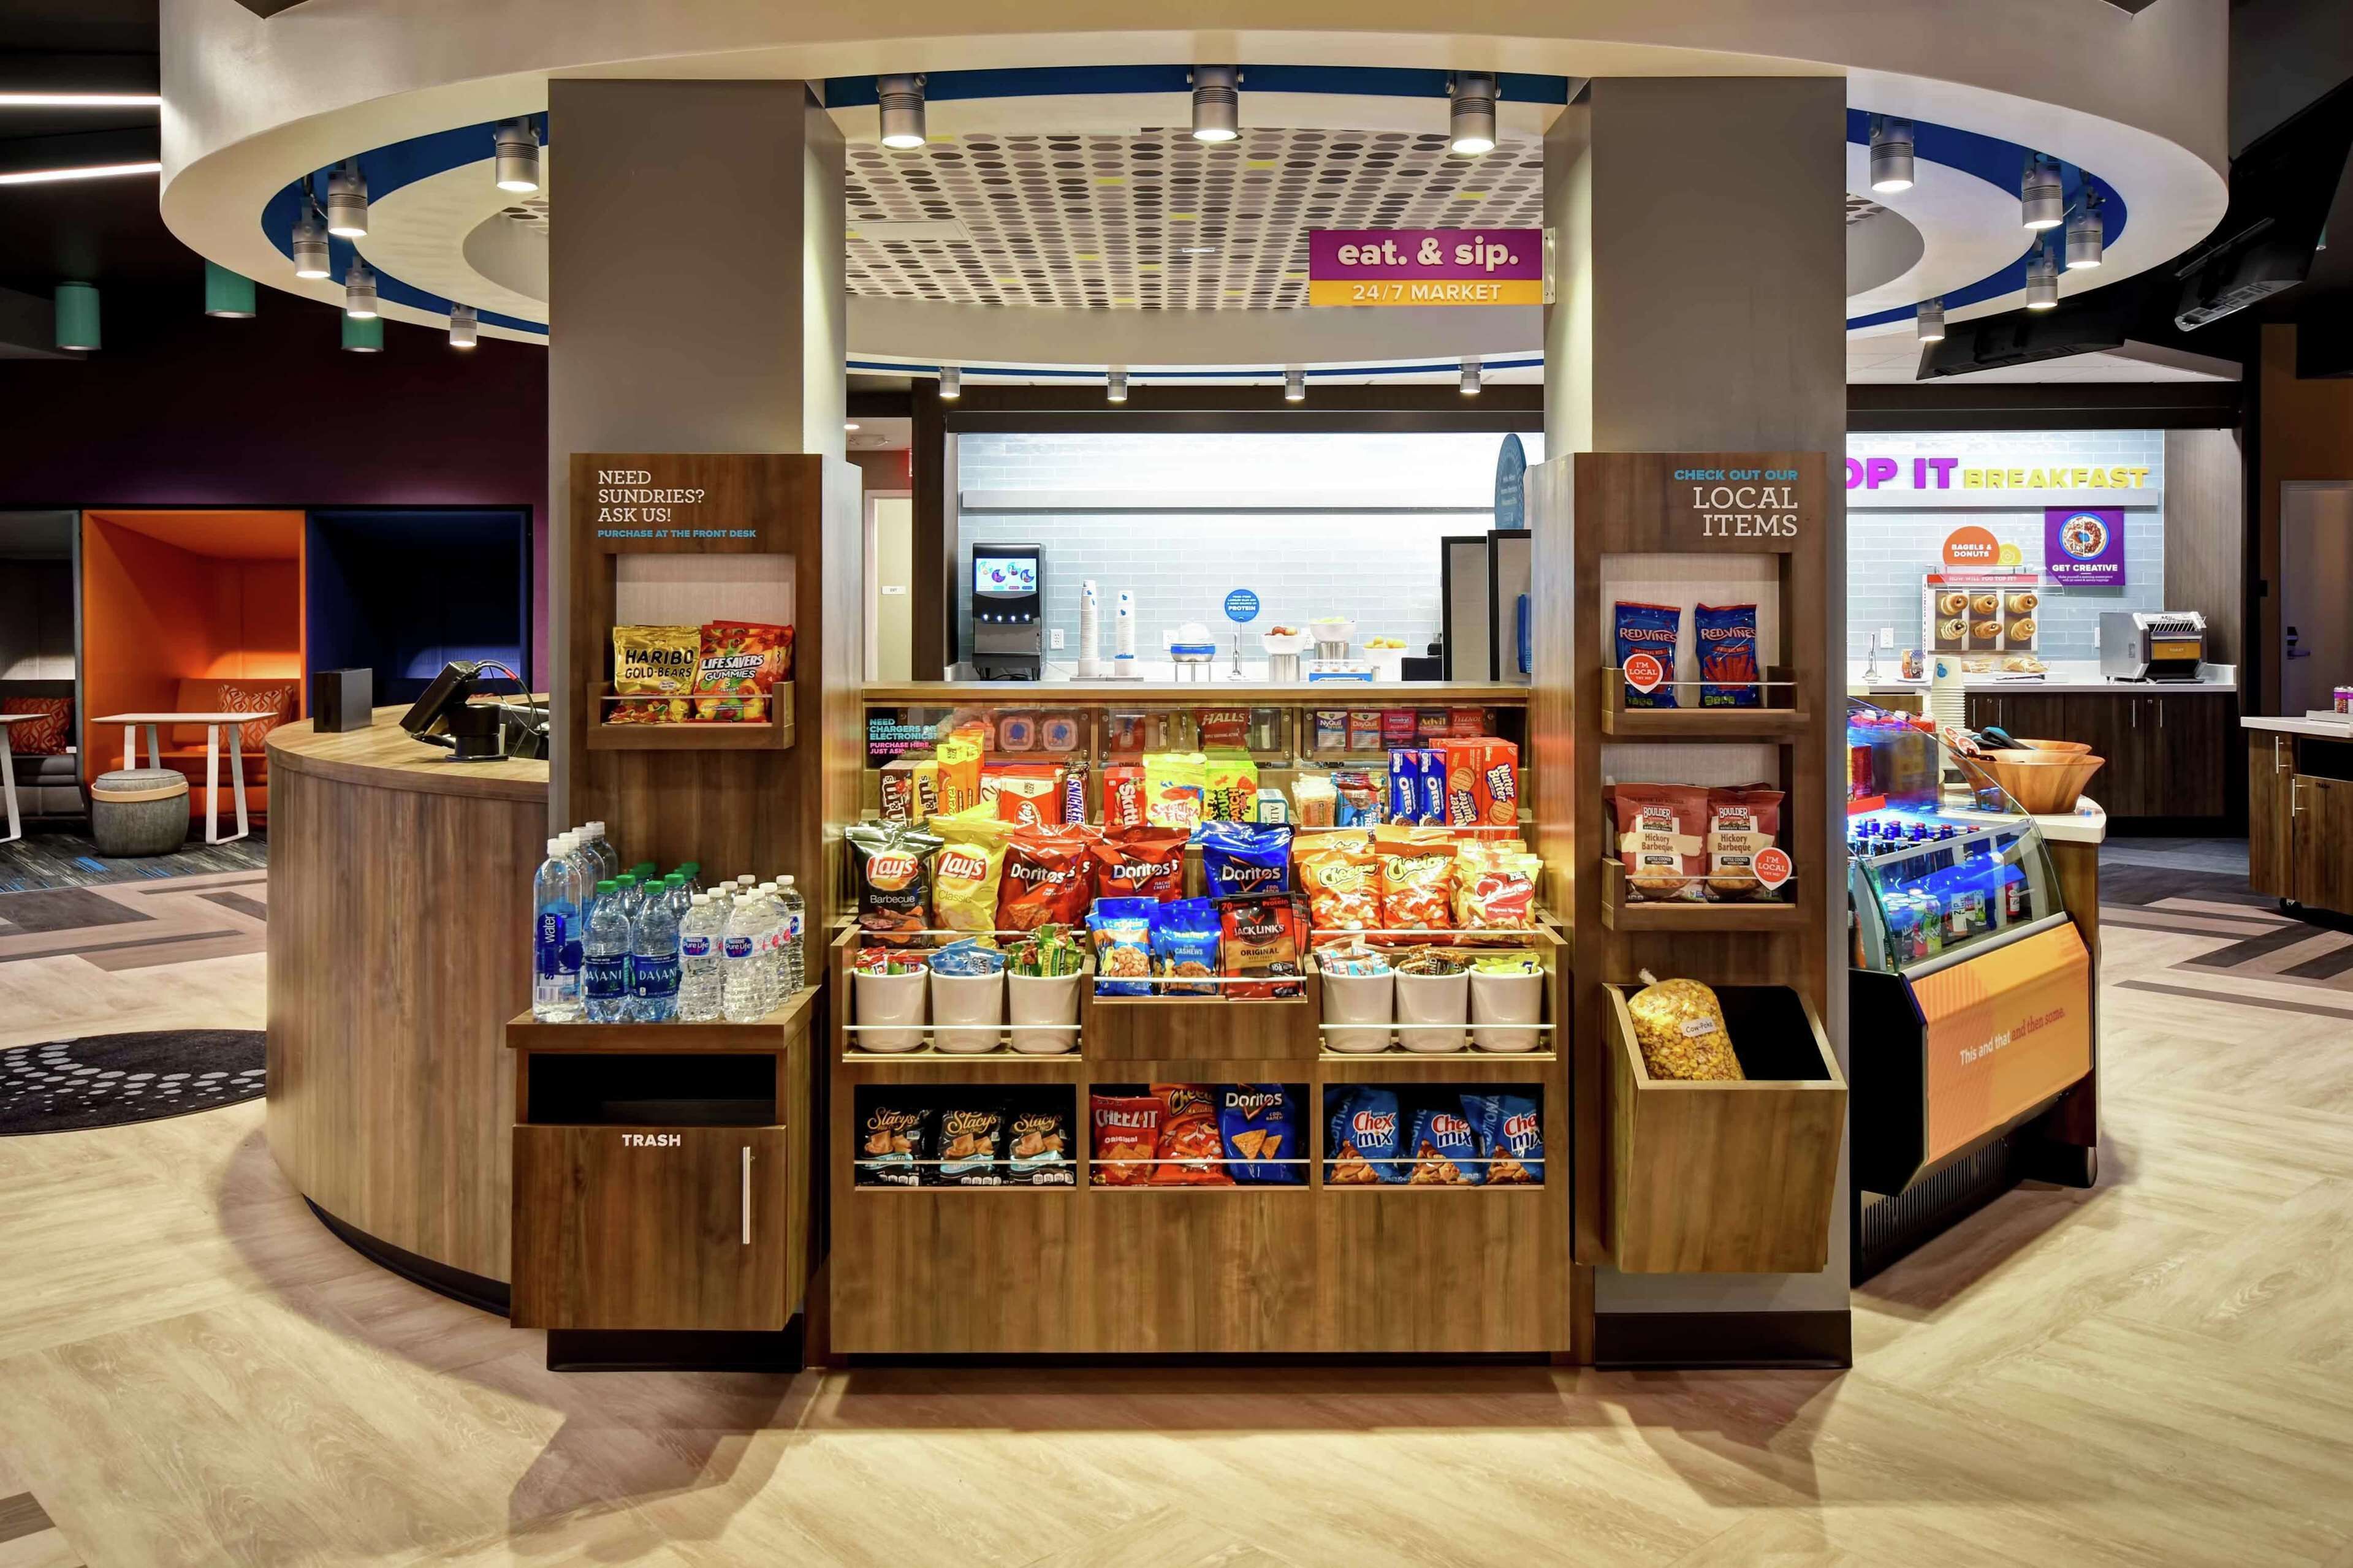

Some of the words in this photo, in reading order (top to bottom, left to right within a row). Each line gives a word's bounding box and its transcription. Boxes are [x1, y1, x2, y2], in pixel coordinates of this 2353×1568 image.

[1337, 239, 1408, 265] eat.
[1417, 237, 1444, 265] &
[1454, 235, 1519, 272] sip.
[1353, 284, 1404, 301] 24/7
[1411, 284, 1502, 301] MARKET
[598, 470, 652, 485] NEED
[1674, 469, 1725, 480] CHECK
[1730, 469, 1760, 480] OUT
[1765, 469, 1798, 480] OUR
[1846, 457, 1898, 490] OP
[1914, 458, 1958, 490] IT
[1963, 468, 2150, 489] BREAKFAST
[598, 489, 705, 504] SUNDRIES?
[1693, 487, 1799, 509] LOCAL
[598, 508, 637, 522] ASK
[642, 508, 672, 522] US!
[598, 529, 653, 538] PURCHASE
[1703, 514, 1798, 537] ITEMS
[625, 650, 694, 665] HARIBO
[625, 667, 692, 679] GOLD-BEARS
[705, 670, 756, 681] GUMMIES
[1202, 713, 1245, 726] HALLS
[1421, 717, 1446, 725] Advil
[1487, 769, 1507, 801] Butter
[1497, 763, 1515, 798] Nutter
[1073, 780, 1084, 824] SNICKER
[1399, 776, 1412, 814] OREO
[1427, 776, 1440, 814] OREO
[1643, 806, 1671, 820] BOULDER
[1719, 807, 1749, 819] BOULDER
[1644, 833, 1670, 844] Hickory
[1720, 833, 1747, 845] Hickory
[1641, 842, 1674, 854] Barbeque
[1717, 843, 1751, 854] Barbeque
[869, 856, 918, 879] Lay's
[938, 852, 984, 880] Lay's
[1010, 863, 1065, 884] Doritos
[1113, 863, 1171, 879] Doritos
[1222, 866, 1281, 881] Doritos
[1757, 863, 1787, 872] LOCAL
[870, 893, 915, 905] Barbecue
[938, 888, 971, 903] Classic
[1233, 926, 1255, 936] JACK
[1256, 924, 1285, 935] LINK'S
[697, 941, 709, 950] Life
[1241, 947, 1280, 956] ORIGINAL
[639, 966, 677, 983] DASAN
[1960, 1048, 1977, 1066] This
[1979, 1039, 1993, 1058] and
[1994, 1031, 2011, 1049] that
[2011, 1021, 2026, 1042] and
[2027, 1016, 2043, 1036] then
[1226, 1092, 1282, 1108] Doritos
[867, 1106, 916, 1131] Stacy's
[948, 1109, 997, 1134] Stacy's
[1013, 1112, 1063, 1134] Stacy's
[1353, 1111, 1396, 1131] Chex
[1504, 1114, 1537, 1138] Che
[622, 1134, 682, 1147] TRASH
[1357, 1130, 1393, 1148] mix
[1437, 1133, 1472, 1149] mix
[1511, 1130, 1544, 1152] mix
